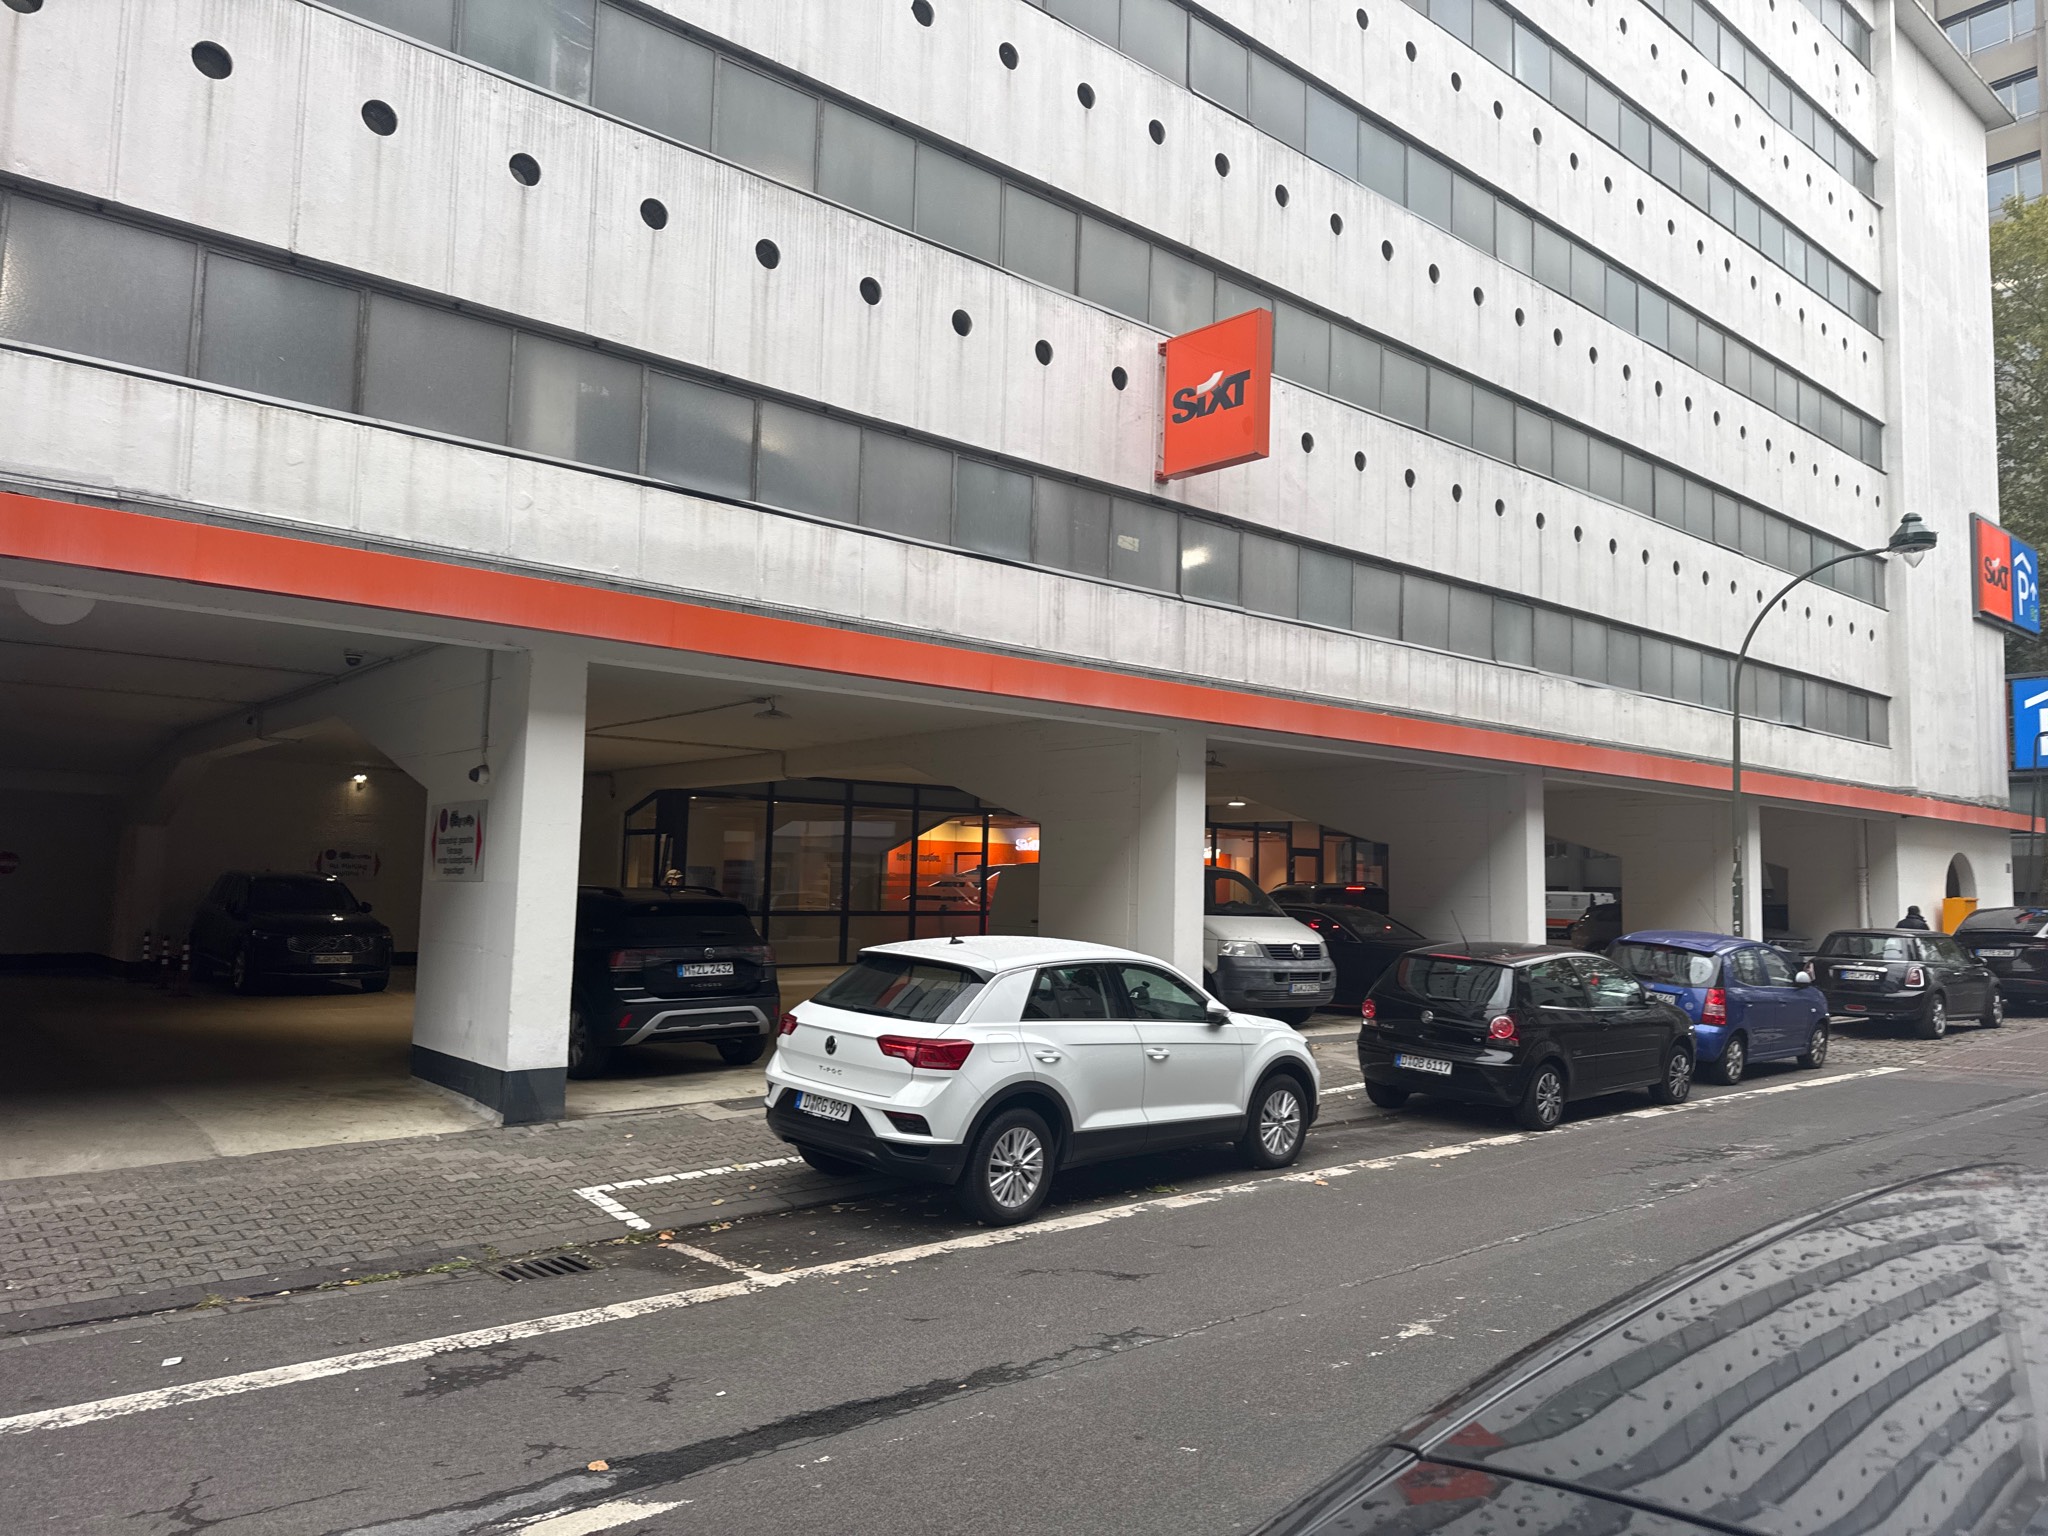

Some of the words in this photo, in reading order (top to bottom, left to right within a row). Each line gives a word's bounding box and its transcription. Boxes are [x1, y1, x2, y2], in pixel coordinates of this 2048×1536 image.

[1171, 370, 1251, 424] SIXT
[2018, 570, 2029, 615] P
[710, 963, 733, 974] 2432
[1426, 1059, 1450, 1073] 6117
[814, 1096, 829, 1113] RG
[829, 1100, 848, 1118] 999
